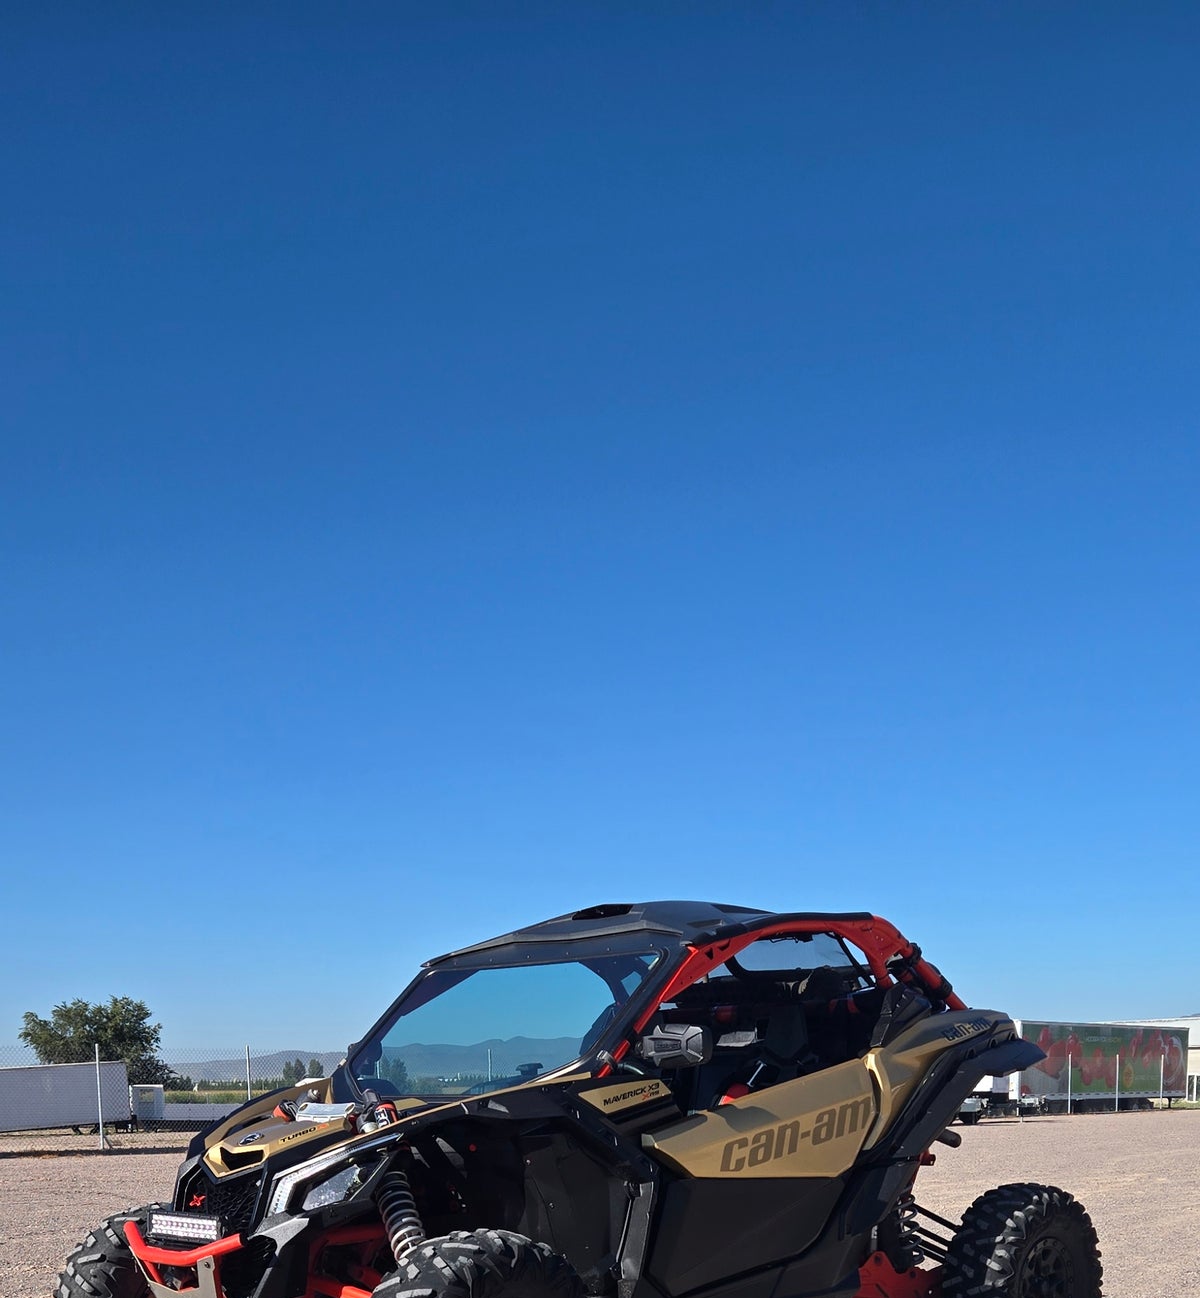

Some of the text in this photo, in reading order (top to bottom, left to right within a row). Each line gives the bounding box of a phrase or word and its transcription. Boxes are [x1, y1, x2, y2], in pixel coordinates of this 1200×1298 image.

[603, 1082, 660, 1107] MAVERICK X3
[280, 1126, 317, 1143] TURBO
[720, 1097, 872, 1172] can-am
